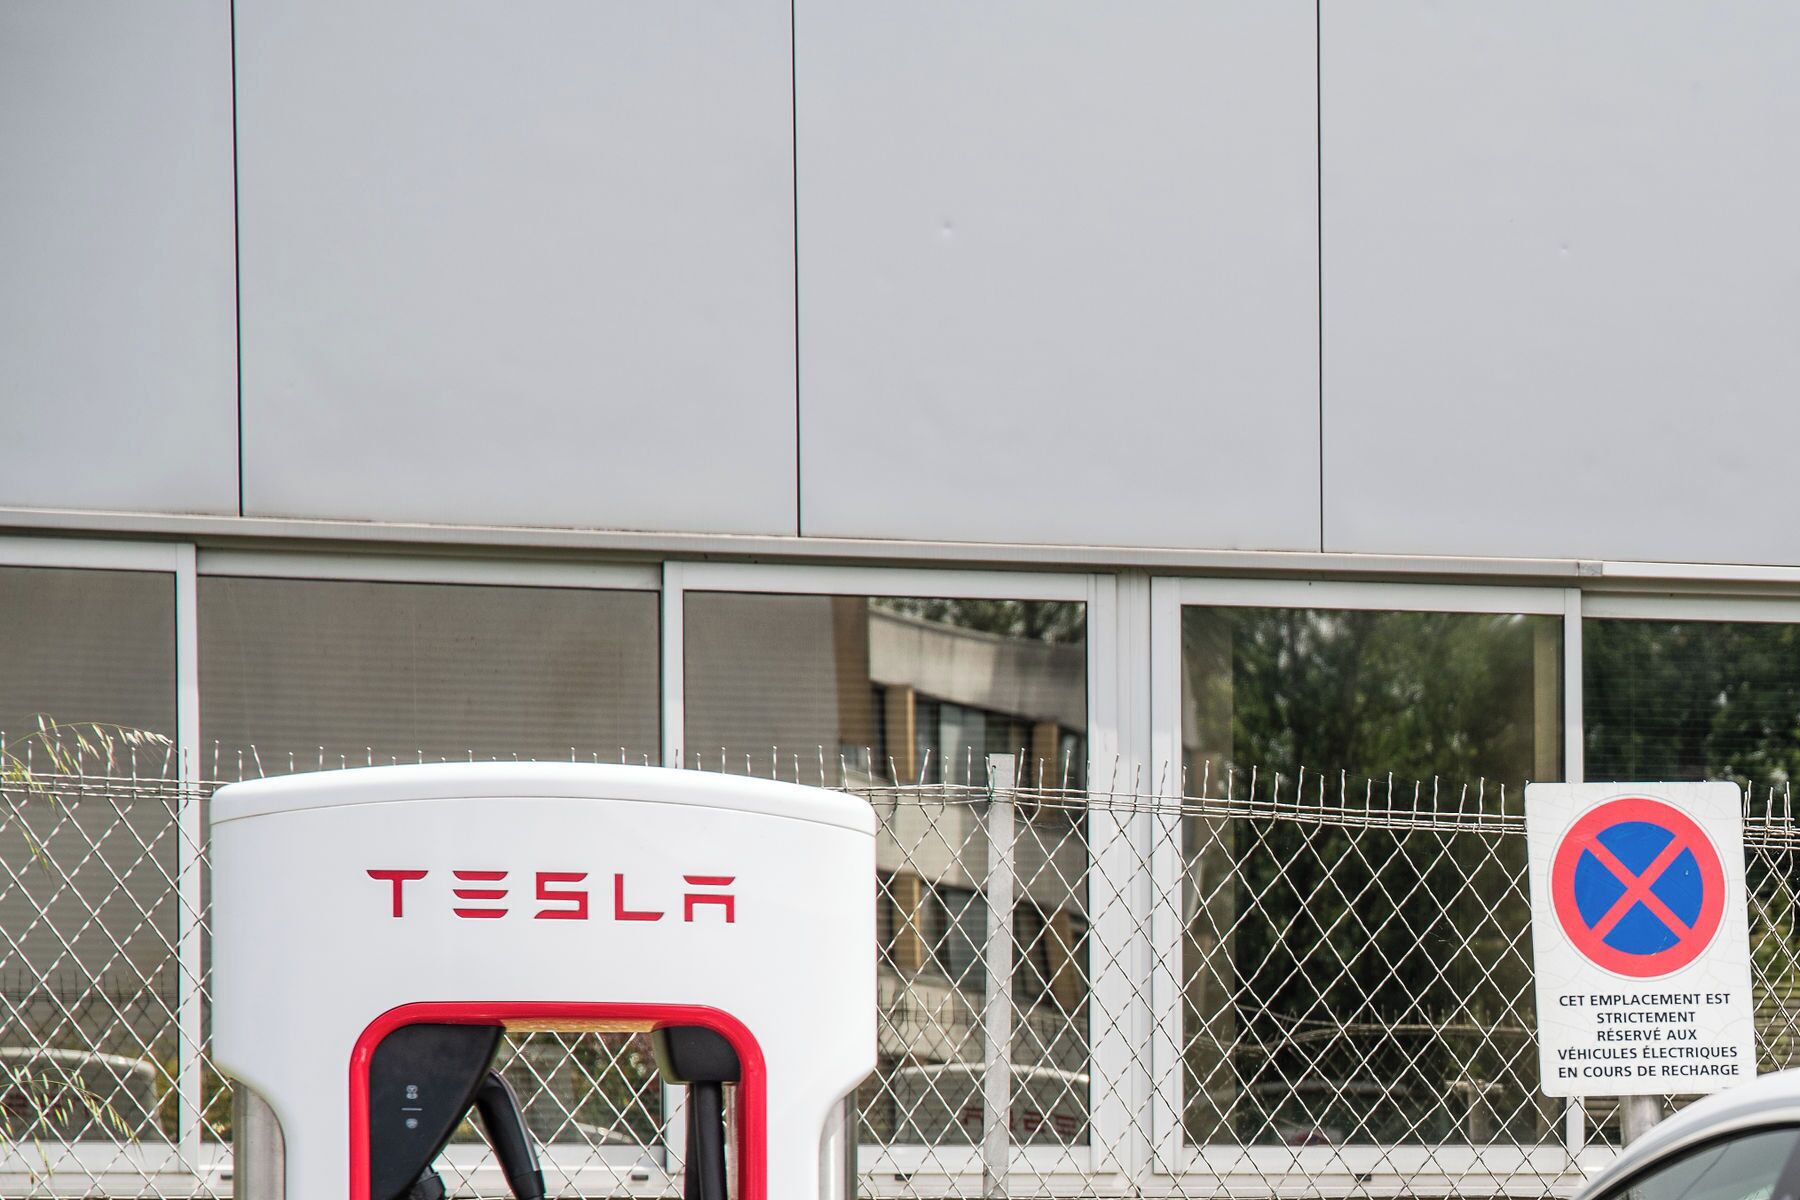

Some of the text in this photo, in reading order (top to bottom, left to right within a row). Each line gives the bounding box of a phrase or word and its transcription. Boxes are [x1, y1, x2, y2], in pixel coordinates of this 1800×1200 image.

[366, 869, 736, 924] TESLA
[1559, 993, 1731, 1007] CET EMPLACEMENT EST
[1596, 1011, 1696, 1024] STRICTEMENT
[1597, 1027, 1697, 1042] RÉSERVÉ AUX
[1557, 1044, 1738, 1061] VÉHICULES ÉLECTRIQUES
[1558, 1064, 1739, 1079] EN COURS DE RECHARGE
